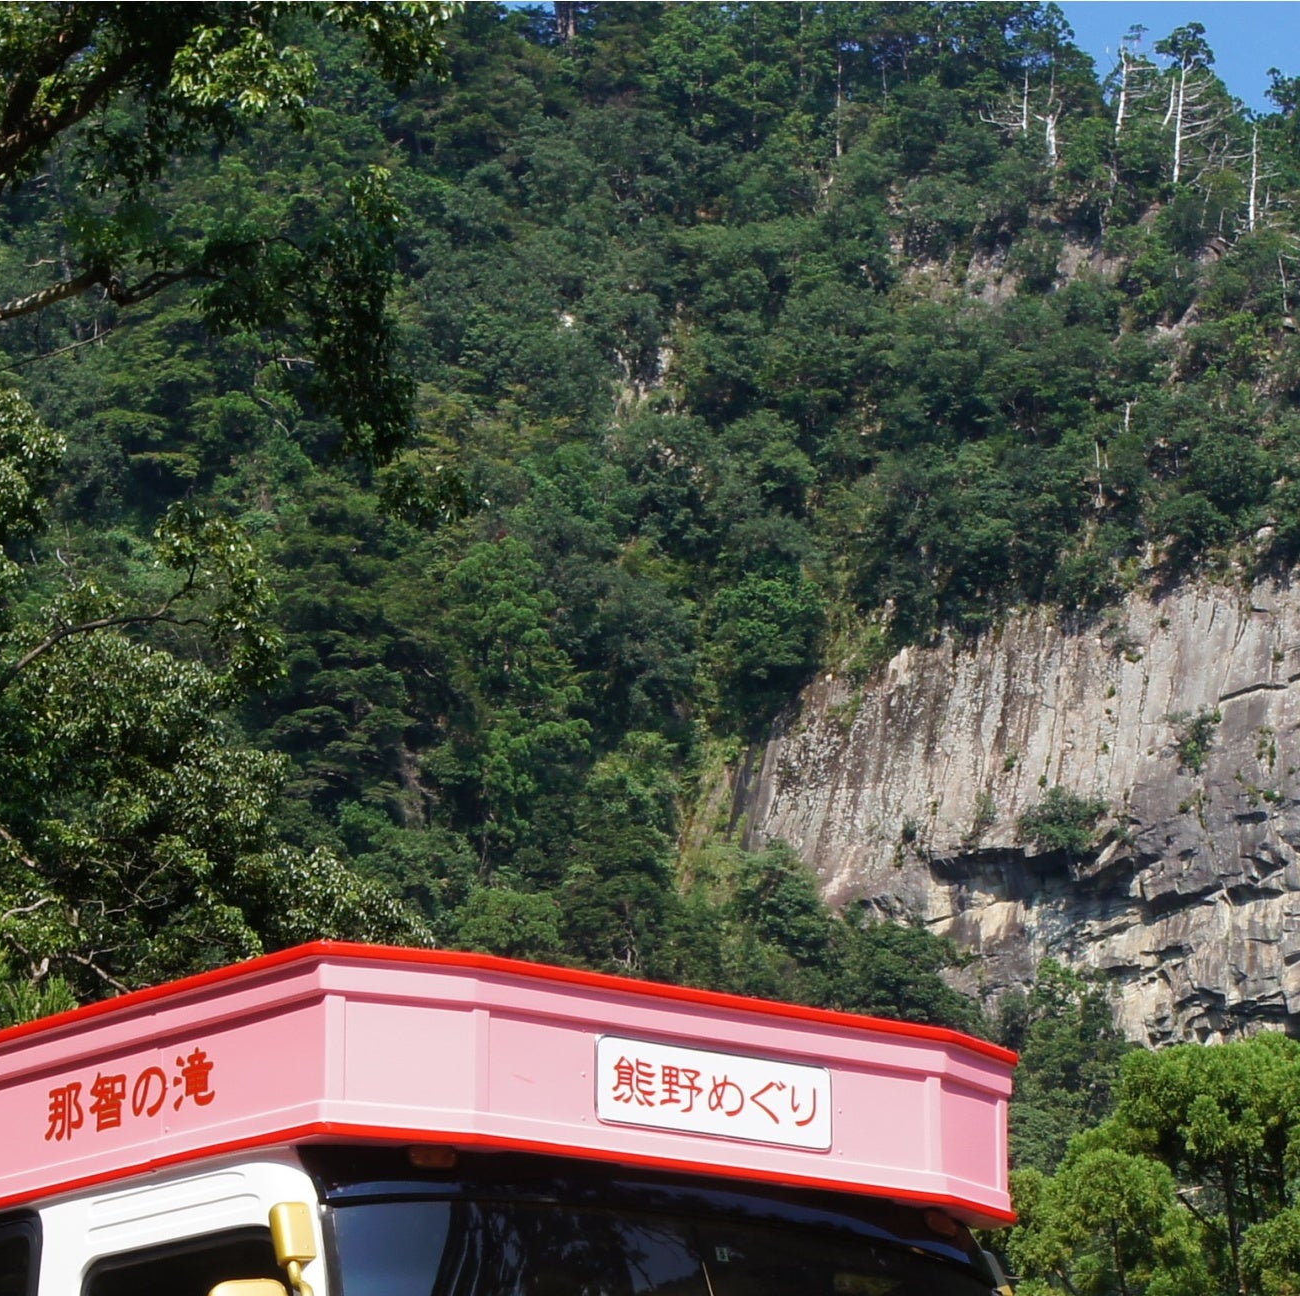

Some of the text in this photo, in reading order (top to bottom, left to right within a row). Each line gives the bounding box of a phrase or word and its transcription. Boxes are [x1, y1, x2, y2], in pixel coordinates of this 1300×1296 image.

[45, 1047, 215, 1141] 那智の滝
[611, 1056, 817, 1126] 熊野めぐり
